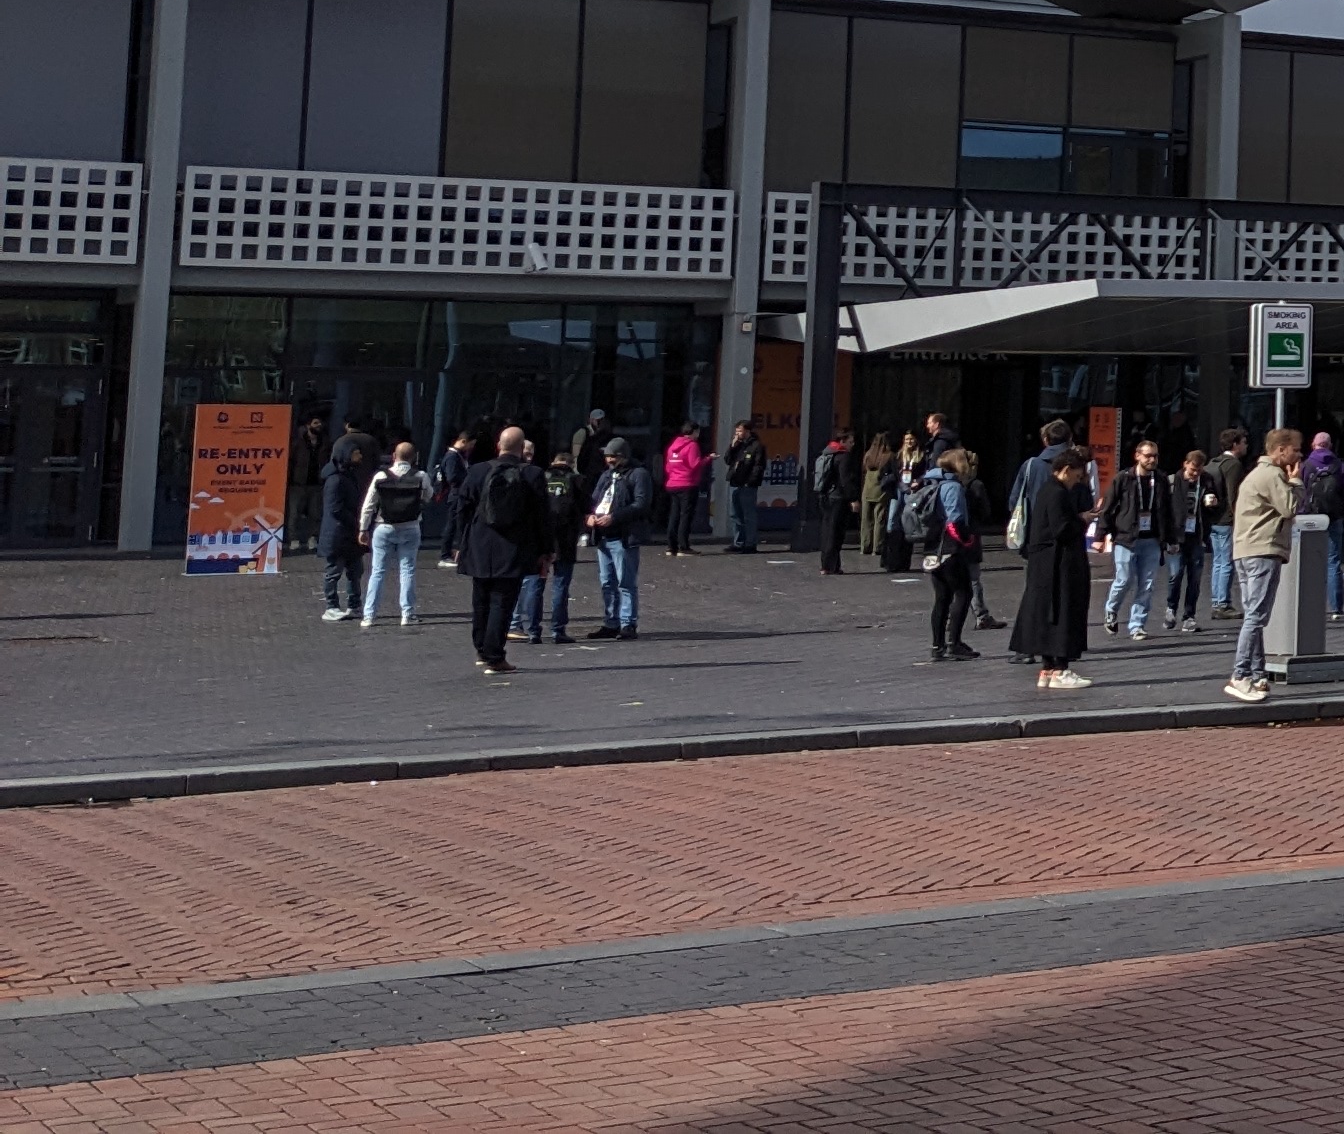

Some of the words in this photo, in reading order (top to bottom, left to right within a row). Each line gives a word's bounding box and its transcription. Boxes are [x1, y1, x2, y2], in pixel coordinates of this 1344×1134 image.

[1267, 311, 1306, 319] SMOKING
[1274, 321, 1299, 329] AREA
[198, 448, 285, 459] RE-ENTRY
[216, 463, 264, 475] ONLY
